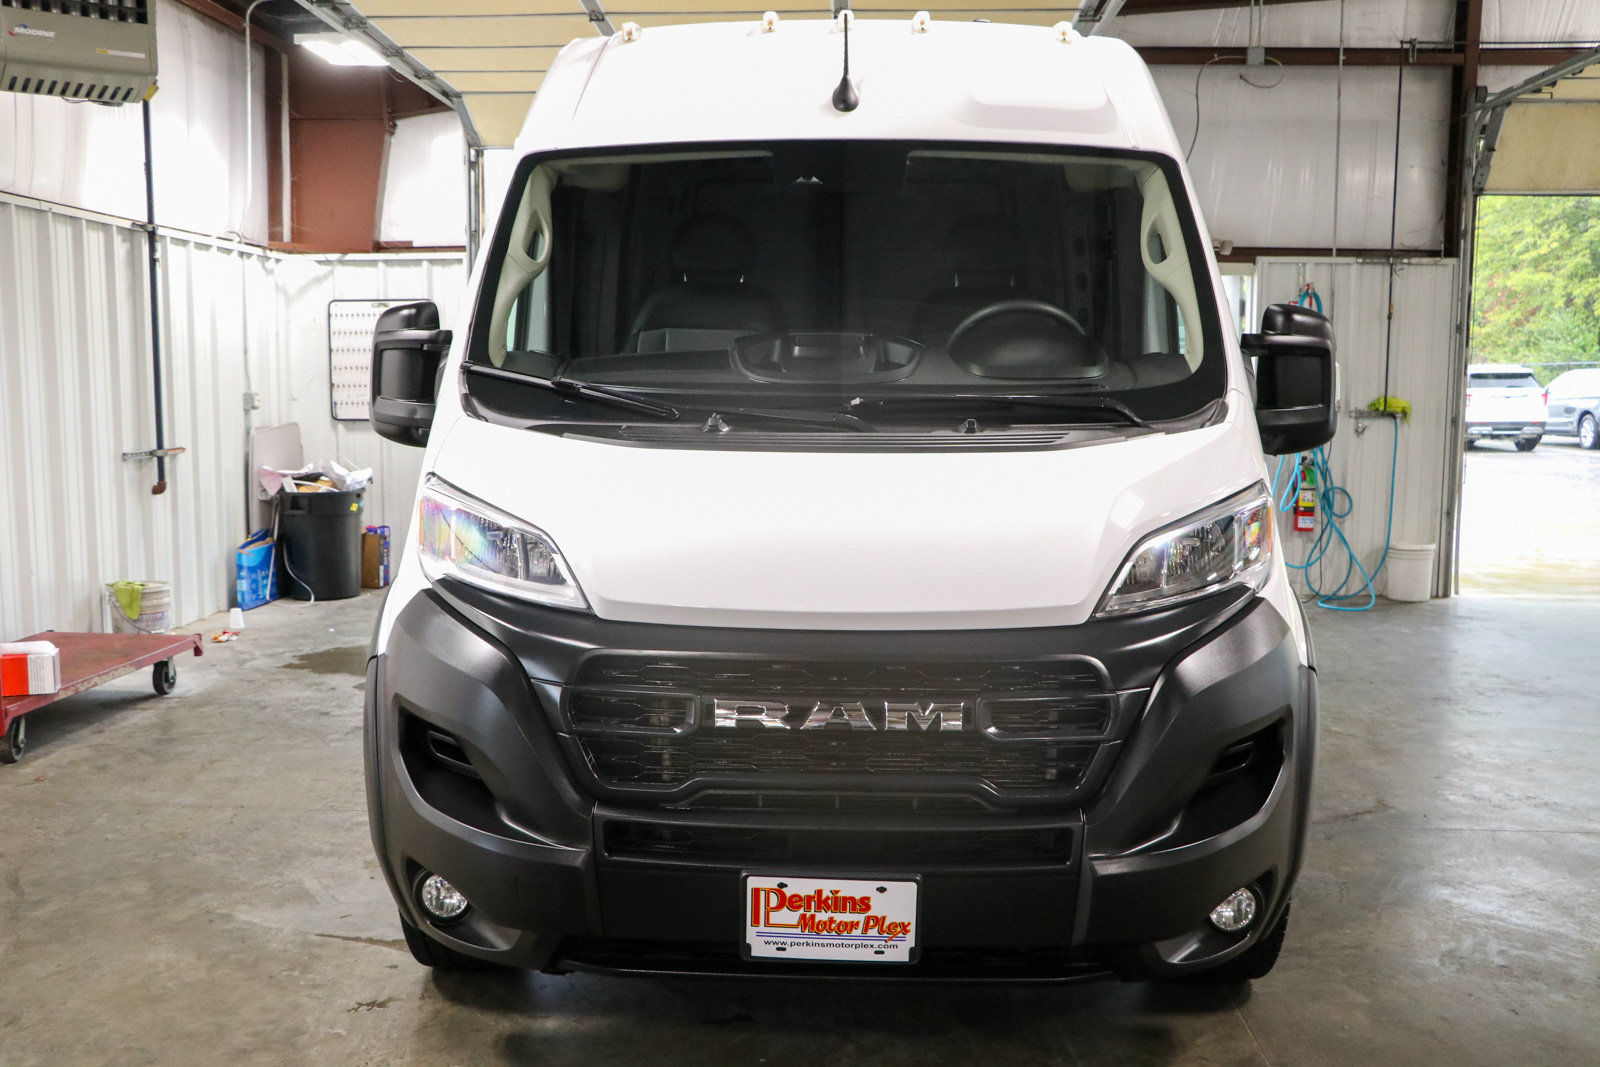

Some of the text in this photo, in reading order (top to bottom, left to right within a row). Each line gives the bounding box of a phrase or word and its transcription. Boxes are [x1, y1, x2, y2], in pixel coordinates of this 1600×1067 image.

[14, 26, 56, 38] MODINE
[714, 699, 963, 731] RAM
[752, 887, 872, 926] Perkins
[797, 913, 911, 942] Motor Plex
[763, 939, 899, 949] www.perkinsmotorplex.com
